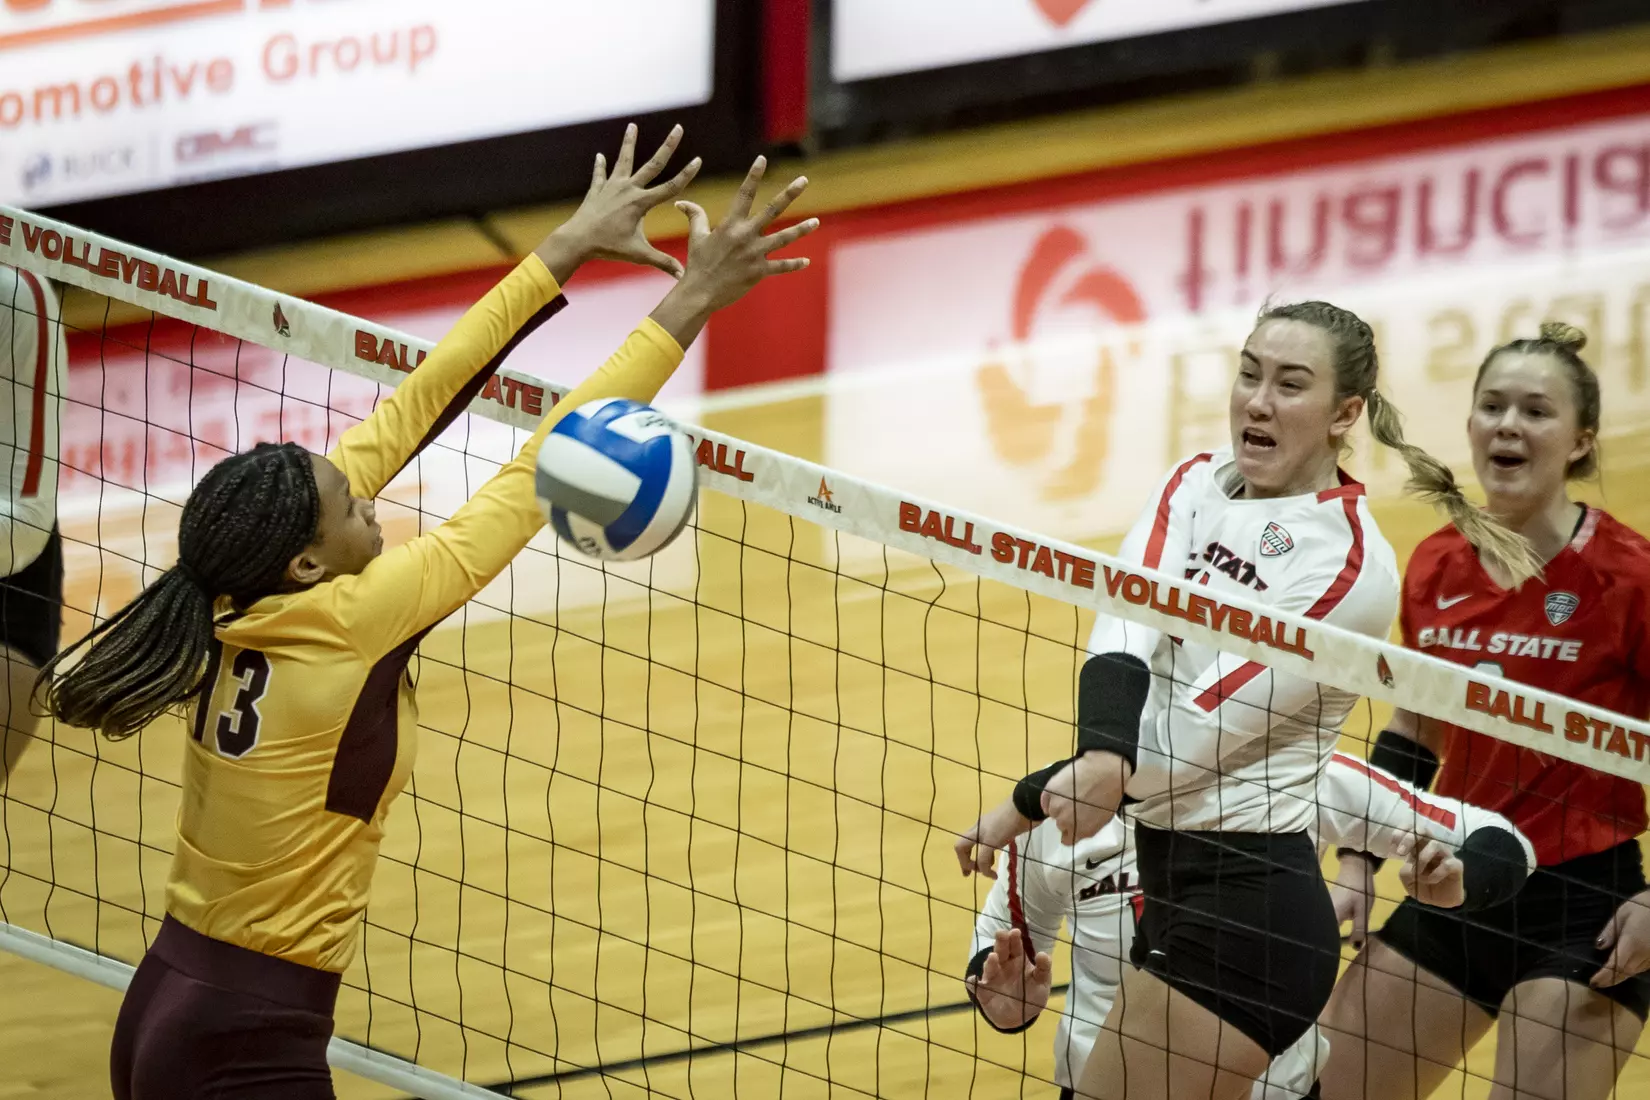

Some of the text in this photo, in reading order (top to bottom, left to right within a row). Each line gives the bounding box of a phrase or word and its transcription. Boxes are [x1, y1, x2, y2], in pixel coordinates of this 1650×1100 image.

[262, 23, 438, 82] Group
[20, 221, 217, 311] VOLLEYBALL
[475, 373, 545, 416] ATE
[899, 501, 1315, 661] BALL STATE VOLLEYBALL
[1418, 627, 1583, 662] BALL STATE
[193, 645, 273, 760] 13
[1465, 680, 1650, 766] BALL STAT
